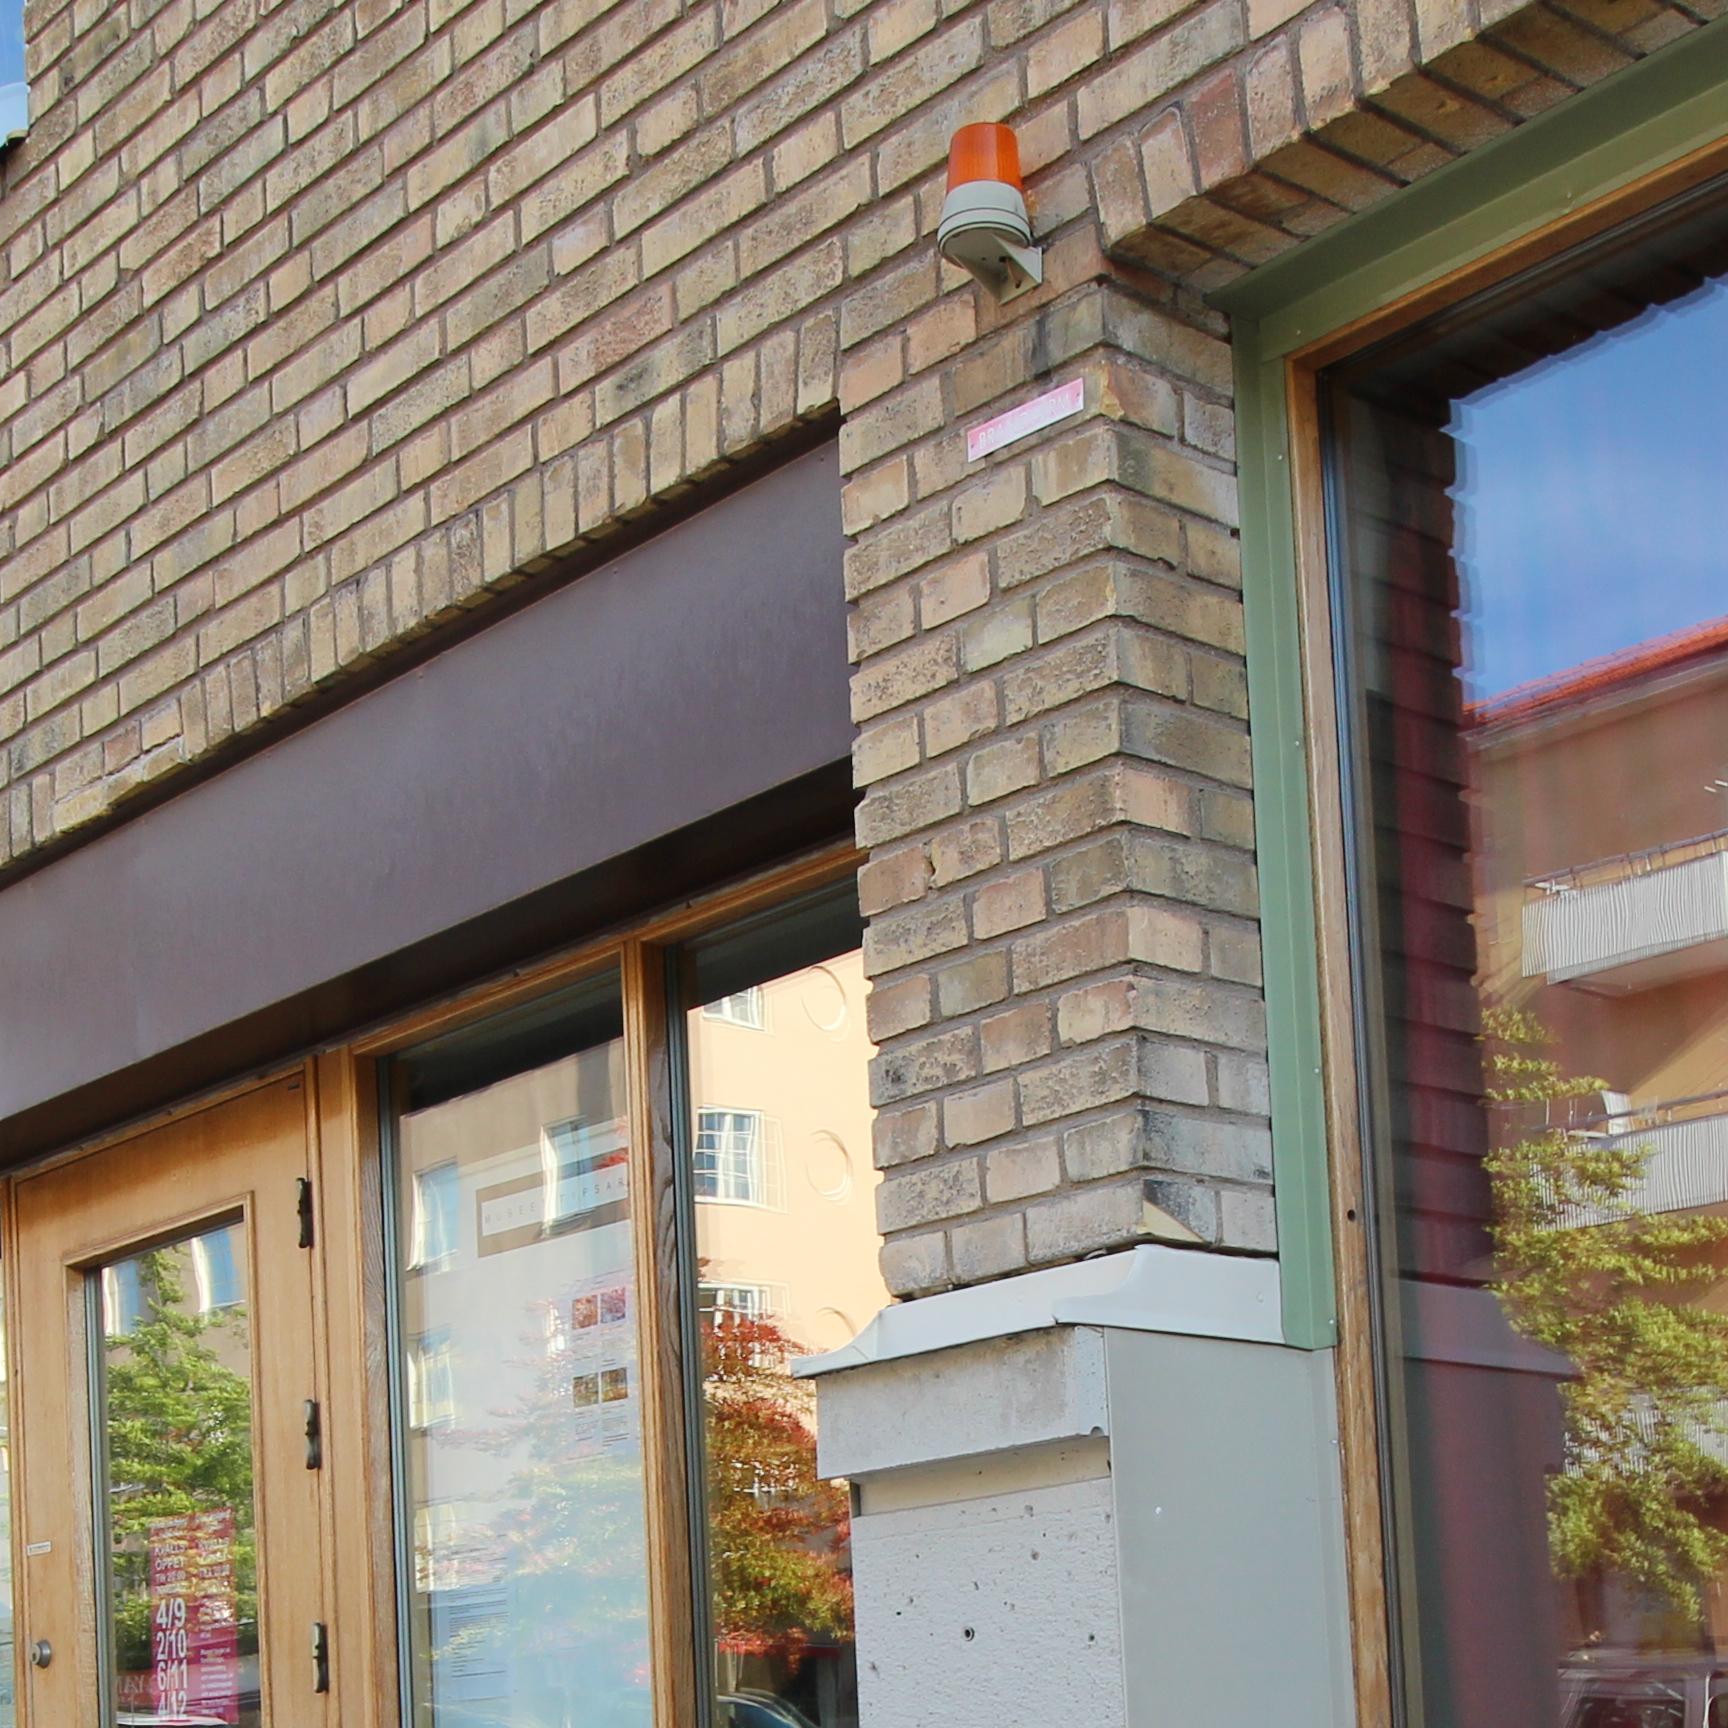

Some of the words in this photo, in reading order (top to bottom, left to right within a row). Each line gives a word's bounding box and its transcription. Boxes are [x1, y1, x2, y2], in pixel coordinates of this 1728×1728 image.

[155, 1598, 187, 1629] 4/9
[156, 1630, 188, 1660] 2/10
[156, 1660, 189, 1691] 6/11
[156, 1691, 189, 1718] 4/12
